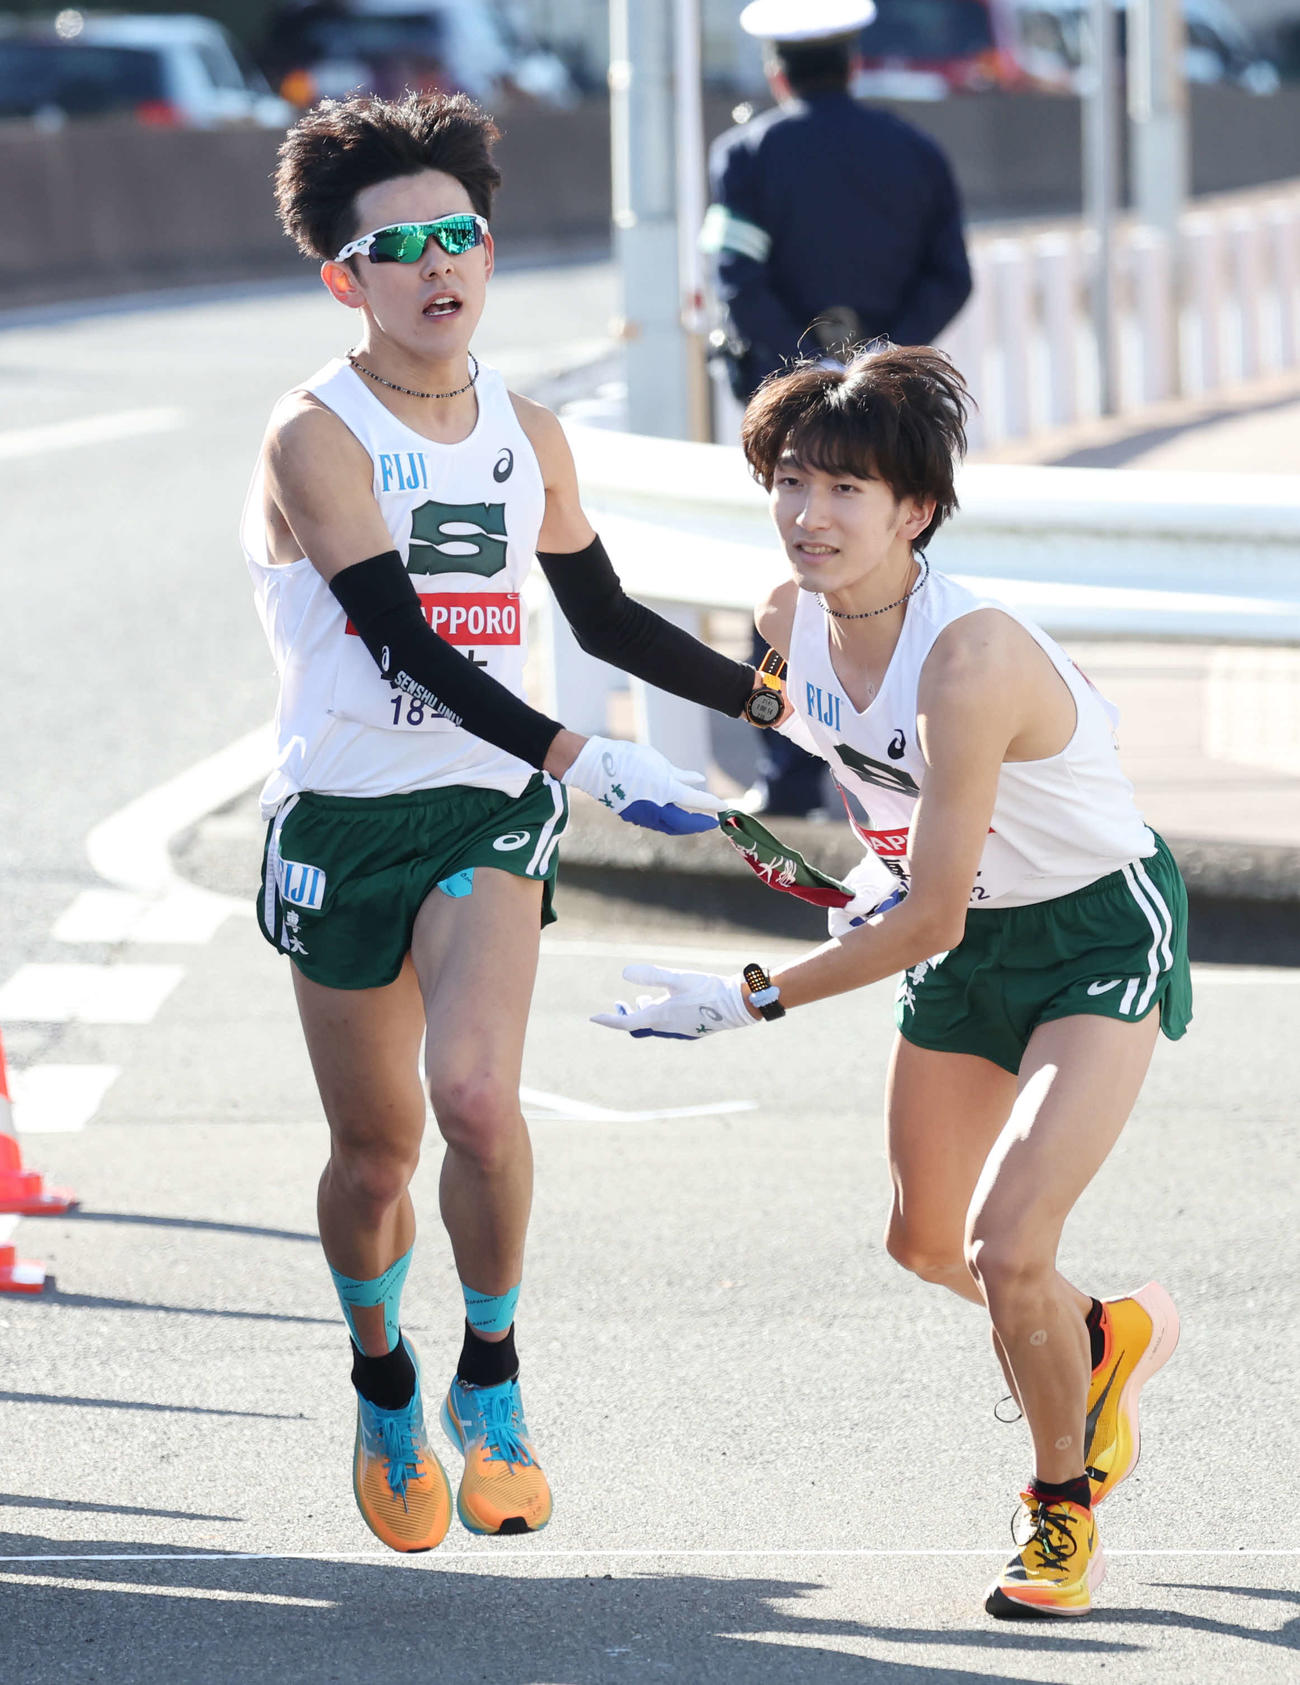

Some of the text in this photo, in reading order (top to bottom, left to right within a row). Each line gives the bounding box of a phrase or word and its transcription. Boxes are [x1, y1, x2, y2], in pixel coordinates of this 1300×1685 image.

[379, 453, 428, 491] FIJI
[406, 500, 507, 578] S
[421, 605, 516, 635] PPORO
[394, 670, 438, 708] SENSHU
[806, 681, 841, 732] FIJI
